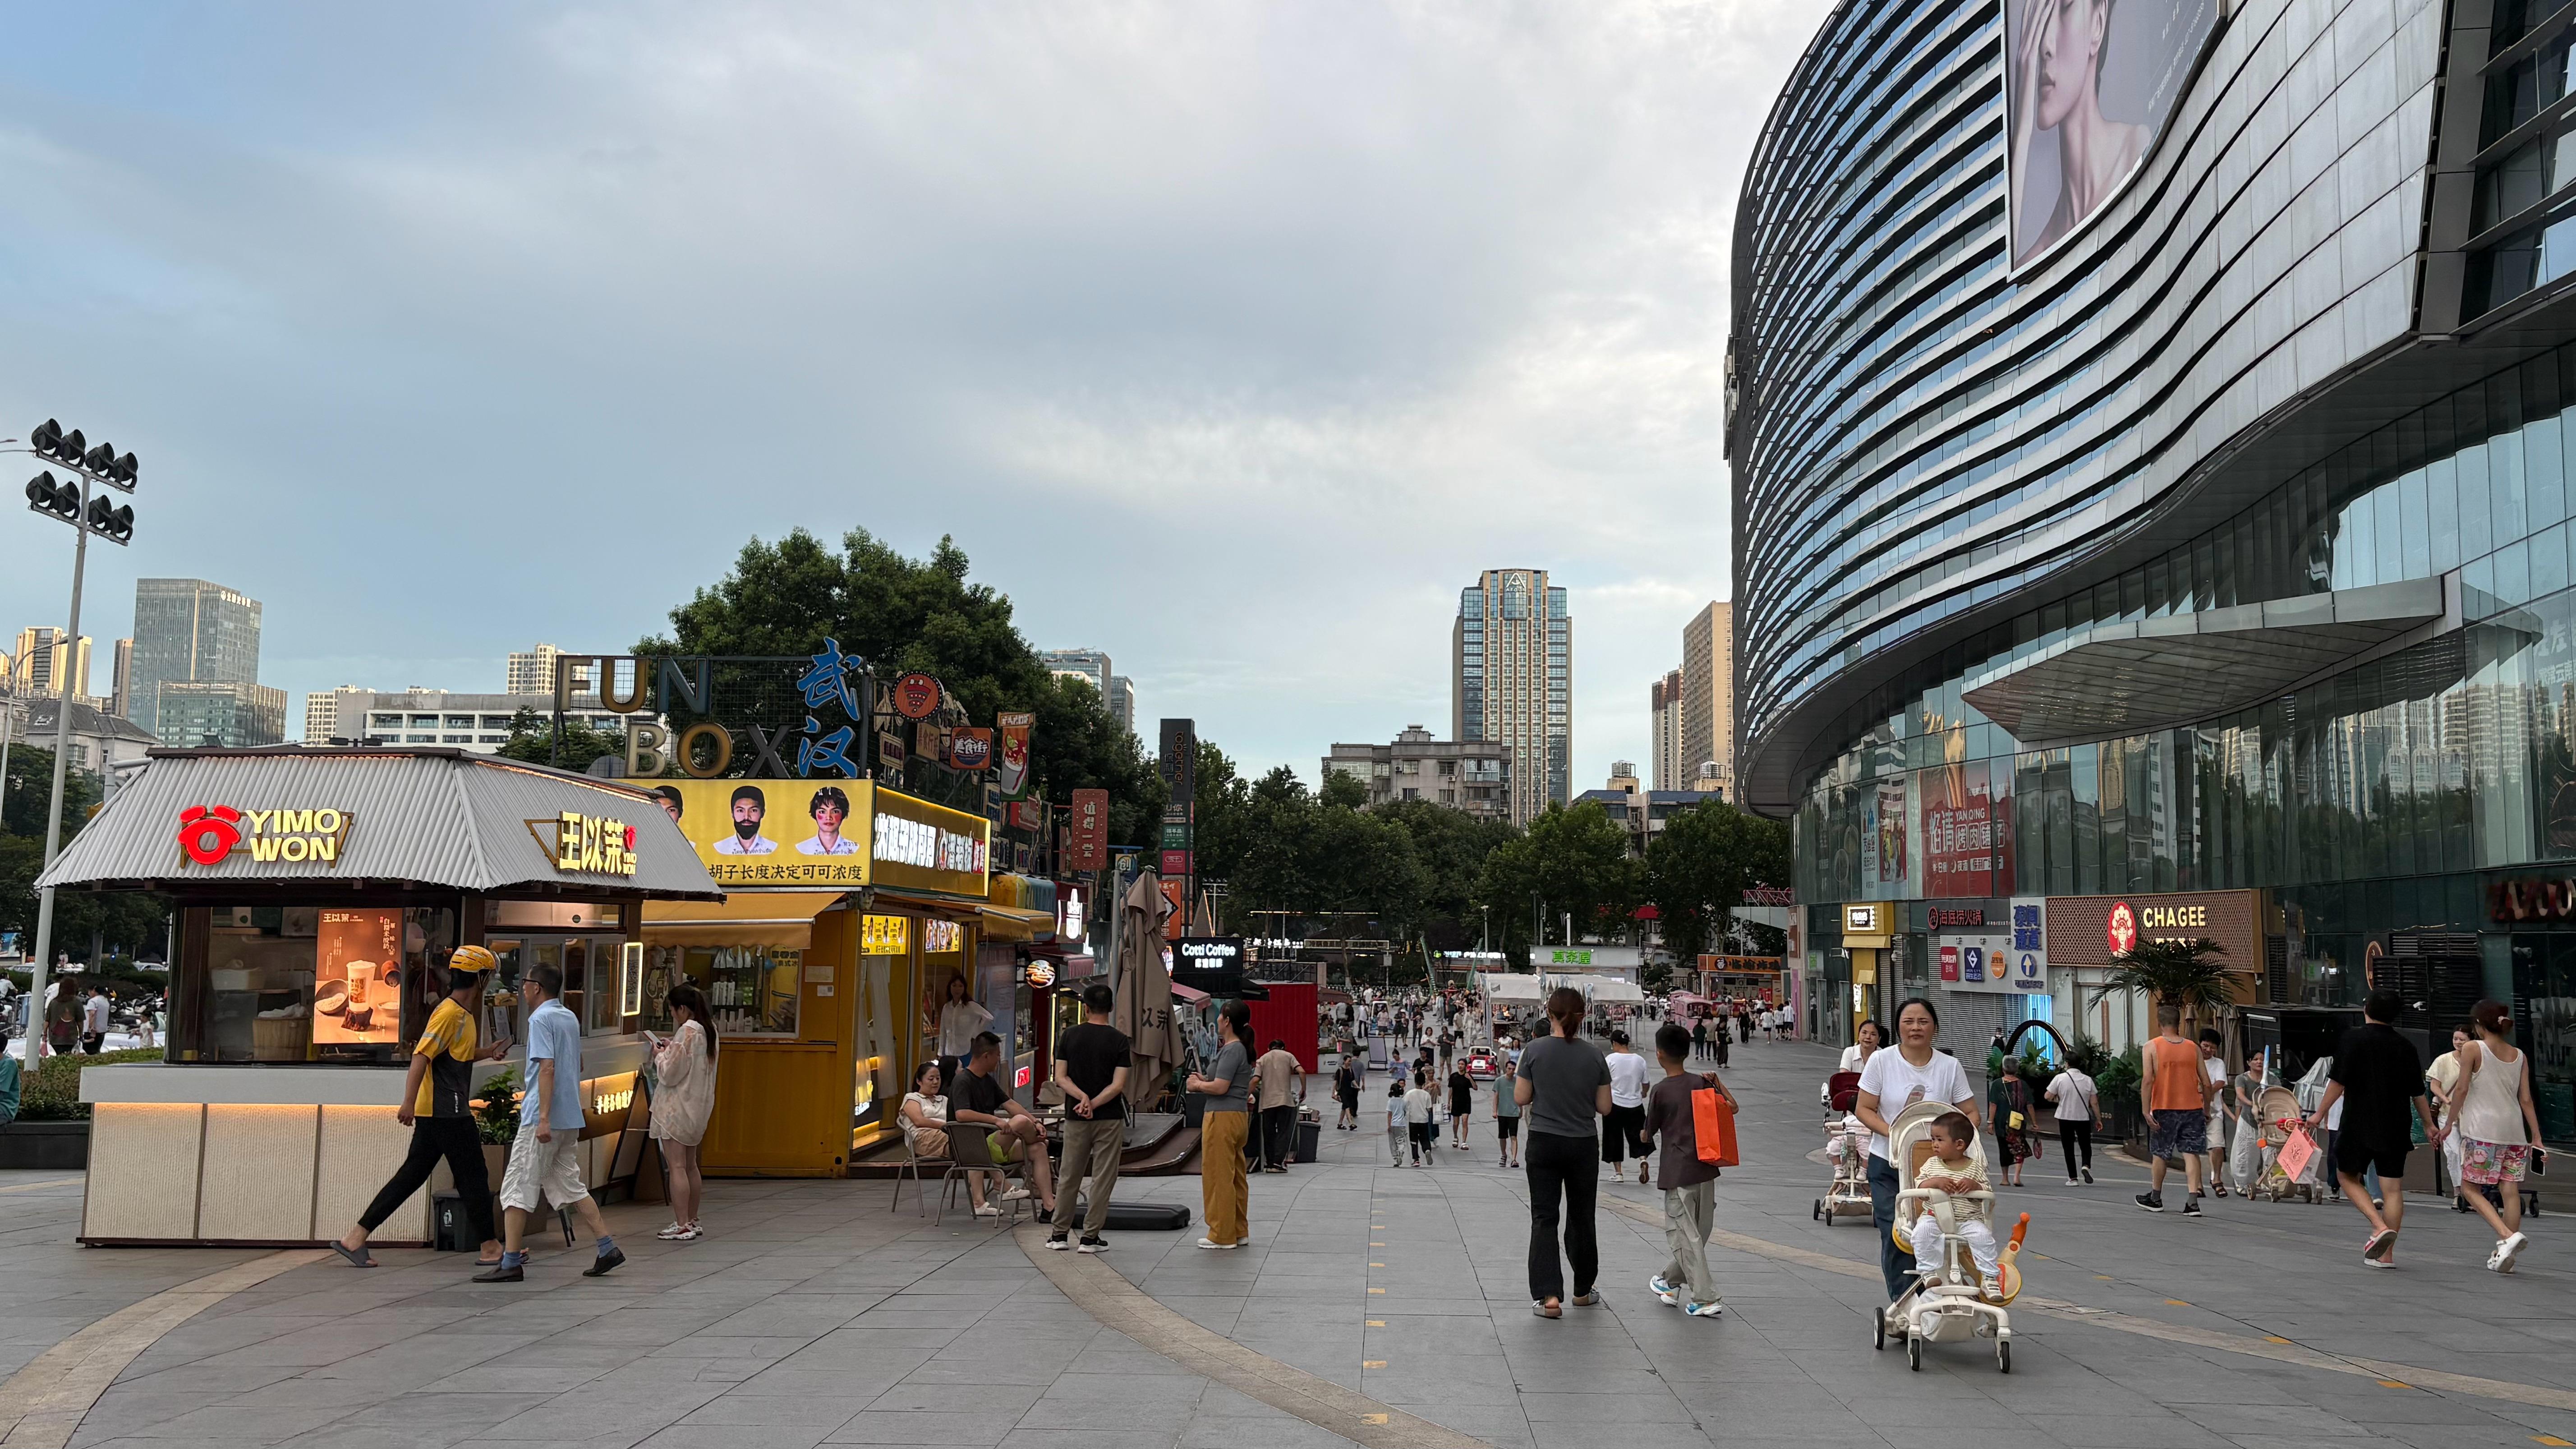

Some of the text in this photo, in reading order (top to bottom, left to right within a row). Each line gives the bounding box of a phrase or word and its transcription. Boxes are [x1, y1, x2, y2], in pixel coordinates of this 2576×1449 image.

[560, 655, 712, 714] FUN
[797, 636, 860, 779] 武汉
[626, 722, 792, 779] BOX
[954, 737, 988, 754] 美食街
[245, 808, 341, 834] YIMO
[1955, 808, 1985, 821] YAN QING
[249, 836, 336, 862] WON
[559, 811, 624, 874] 王以茉
[708, 864, 862, 880] 胡子长度决定可可浓度
[1939, 910, 1982, 926] 海底捞火锅
[2143, 906, 2206, 928] CHAGEE
[1182, 943, 1236, 956] Cotti Coffee
